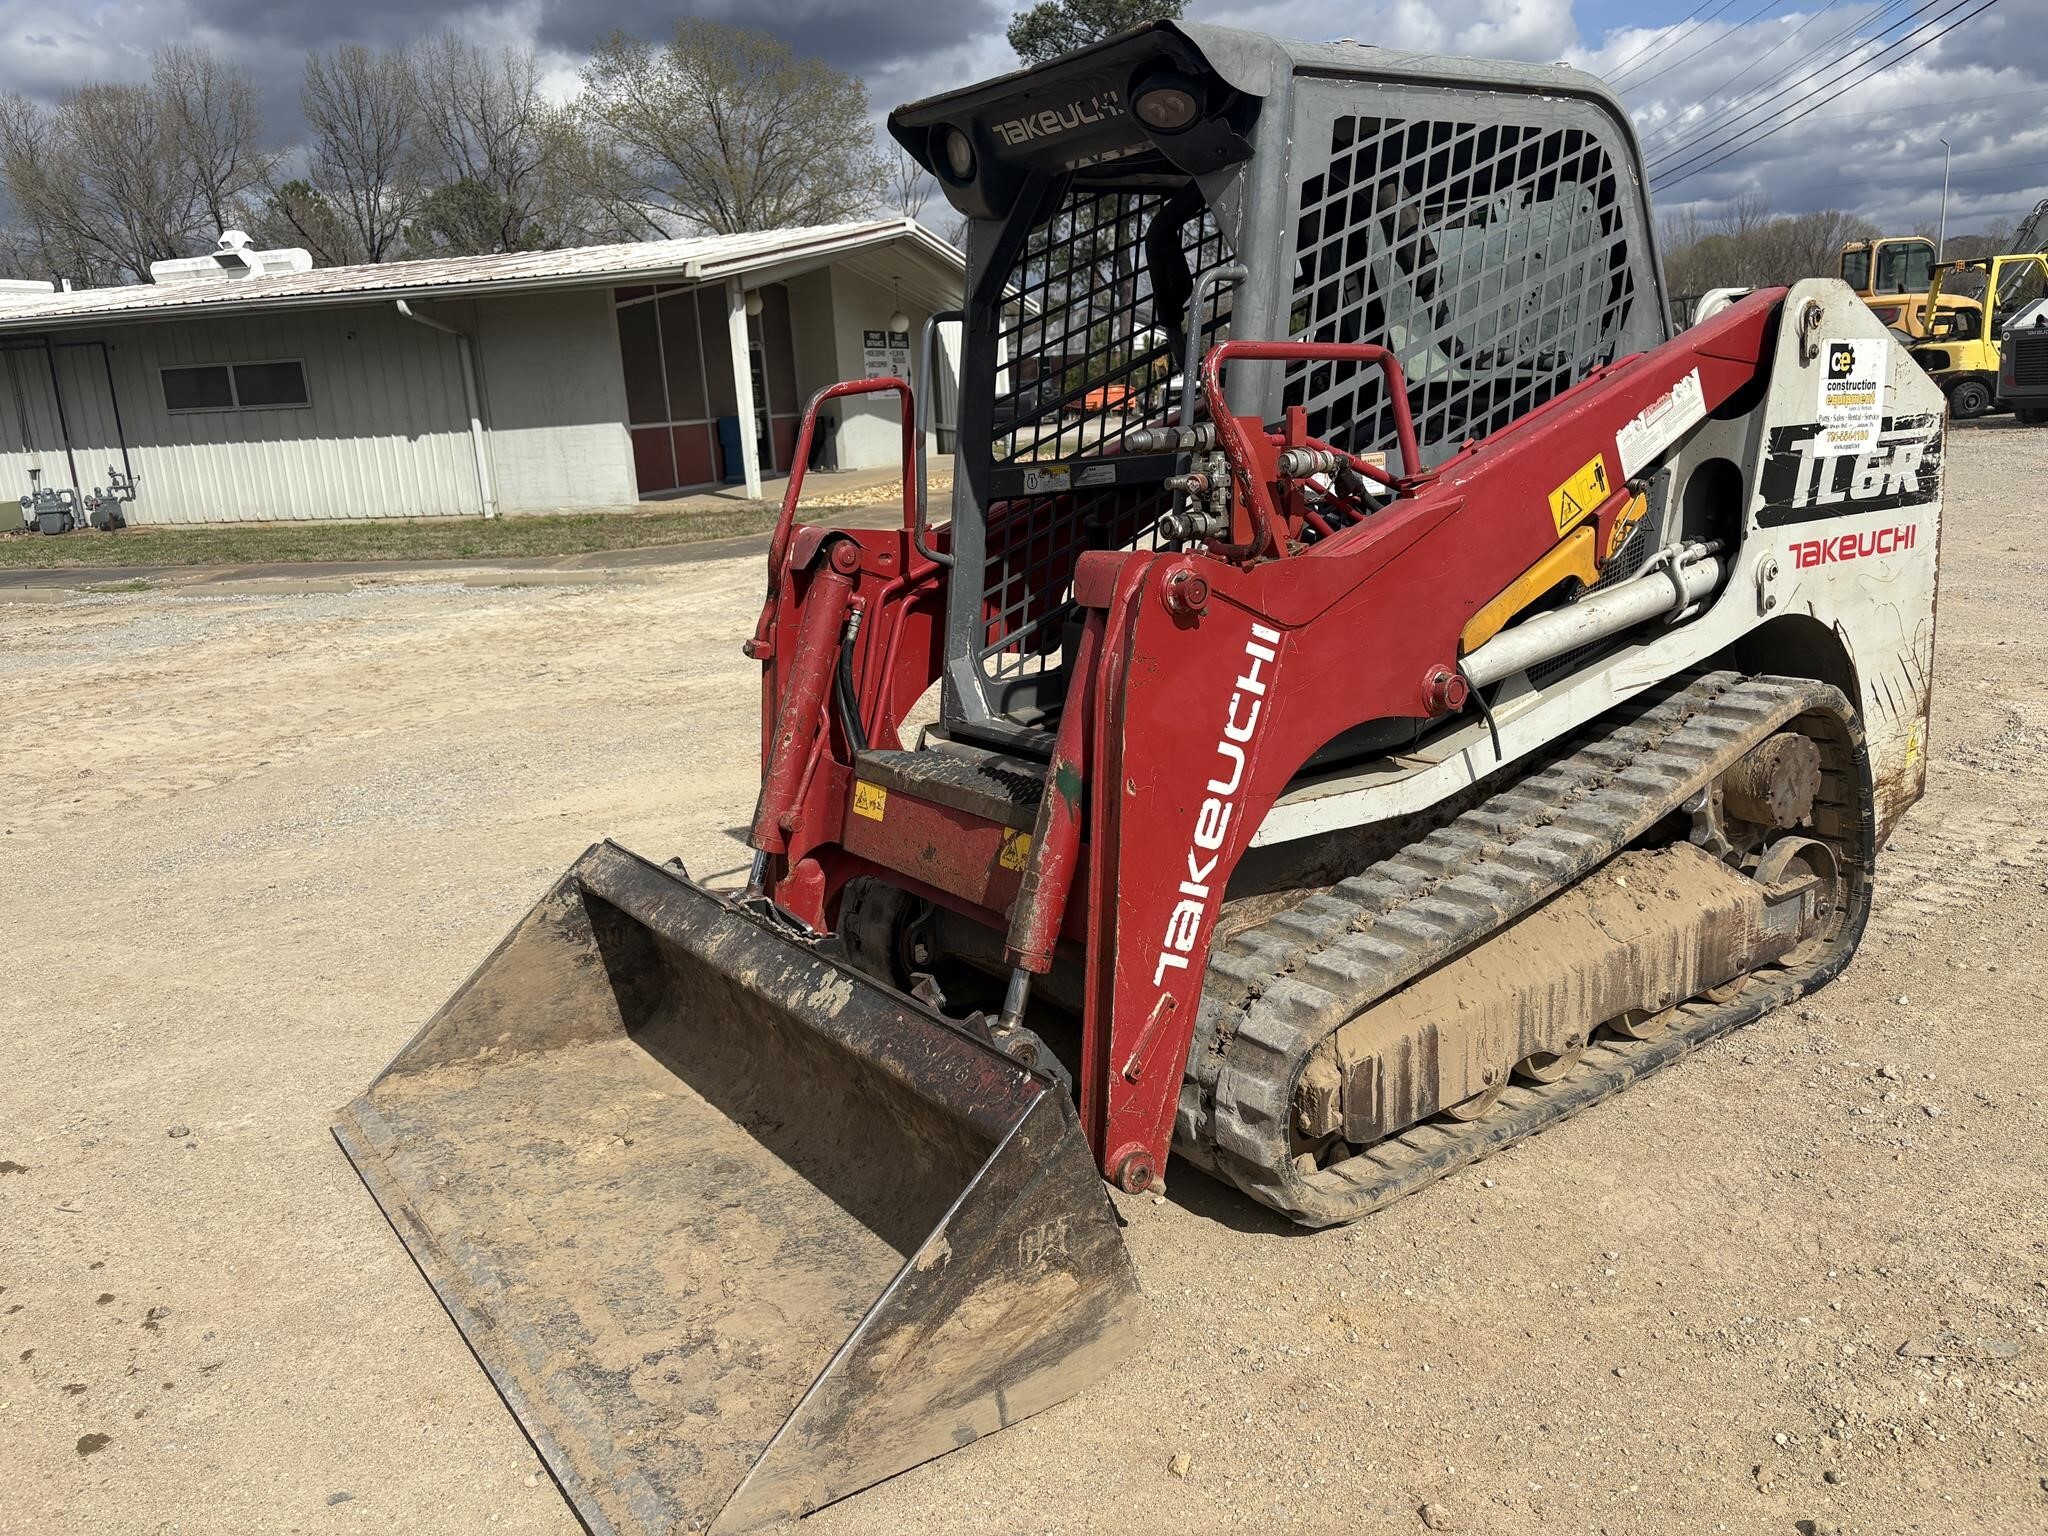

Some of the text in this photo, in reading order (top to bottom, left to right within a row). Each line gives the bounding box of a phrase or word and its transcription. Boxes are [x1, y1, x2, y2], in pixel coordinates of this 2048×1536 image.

[1827, 379, 1876, 391] construction
[1826, 390, 1875, 409] equipment
[1833, 414, 1845, 422] Sales
[1864, 412, 1880, 421] Service
[1789, 524, 1916, 569] TAKEUCHI
[1153, 622, 1281, 987] TAKEUCHI
